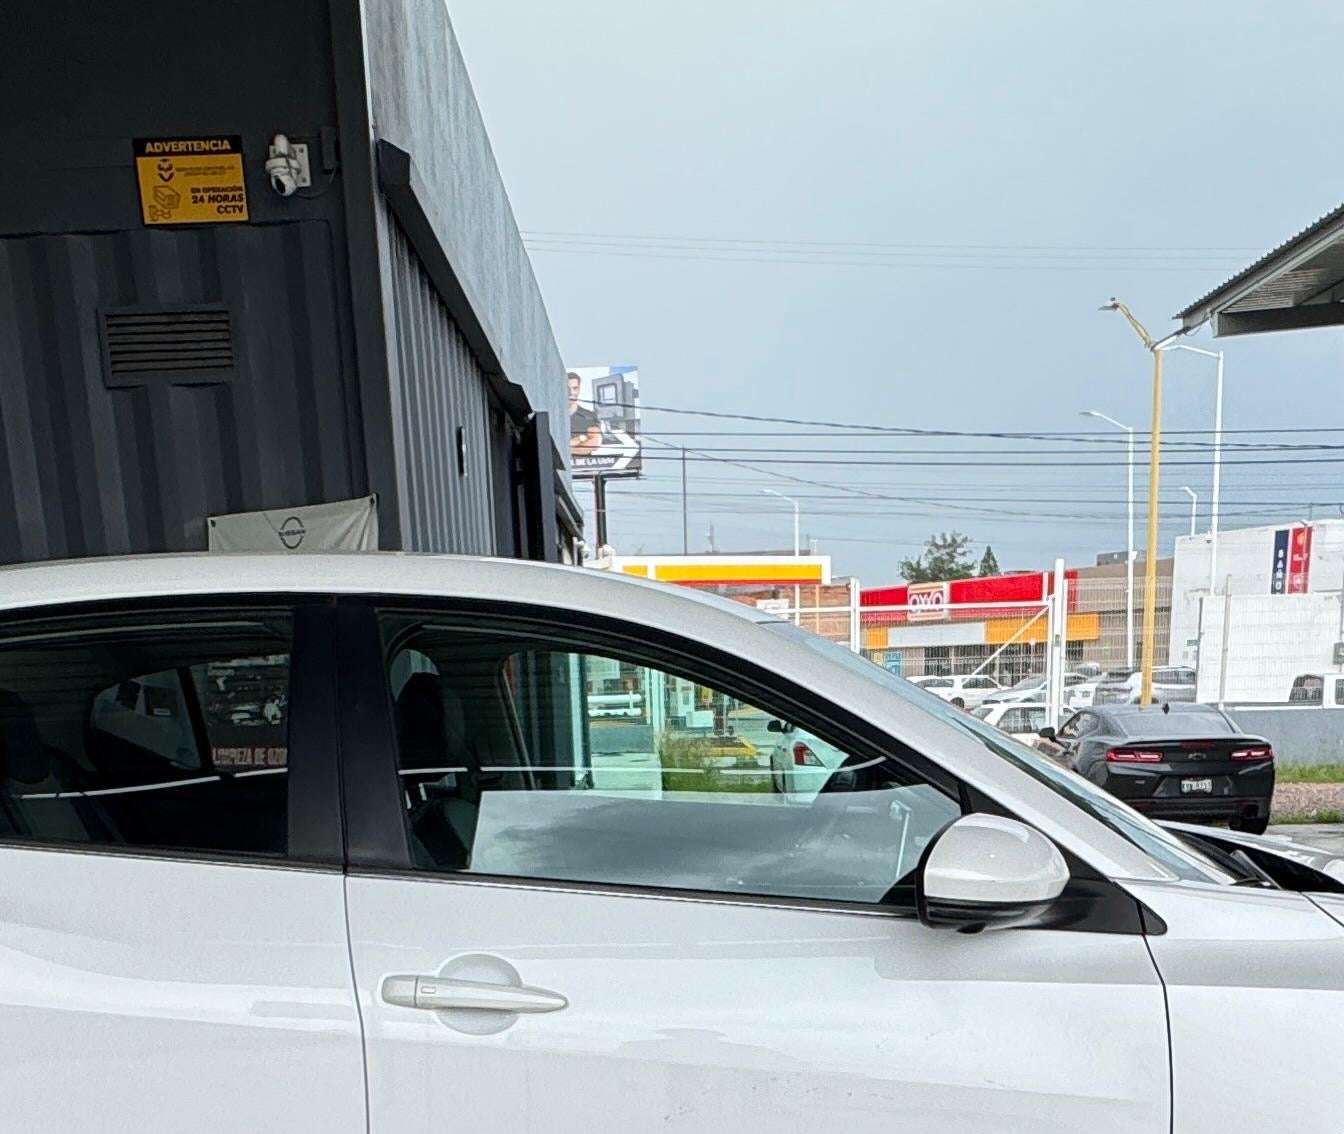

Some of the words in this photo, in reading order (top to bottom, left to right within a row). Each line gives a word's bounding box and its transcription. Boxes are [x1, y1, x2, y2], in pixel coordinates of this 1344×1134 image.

[145, 139, 231, 153] ADVERTENCIA
[192, 195, 205, 204] 24
[208, 193, 244, 204] HORAS
[216, 204, 244, 215] CCTV
